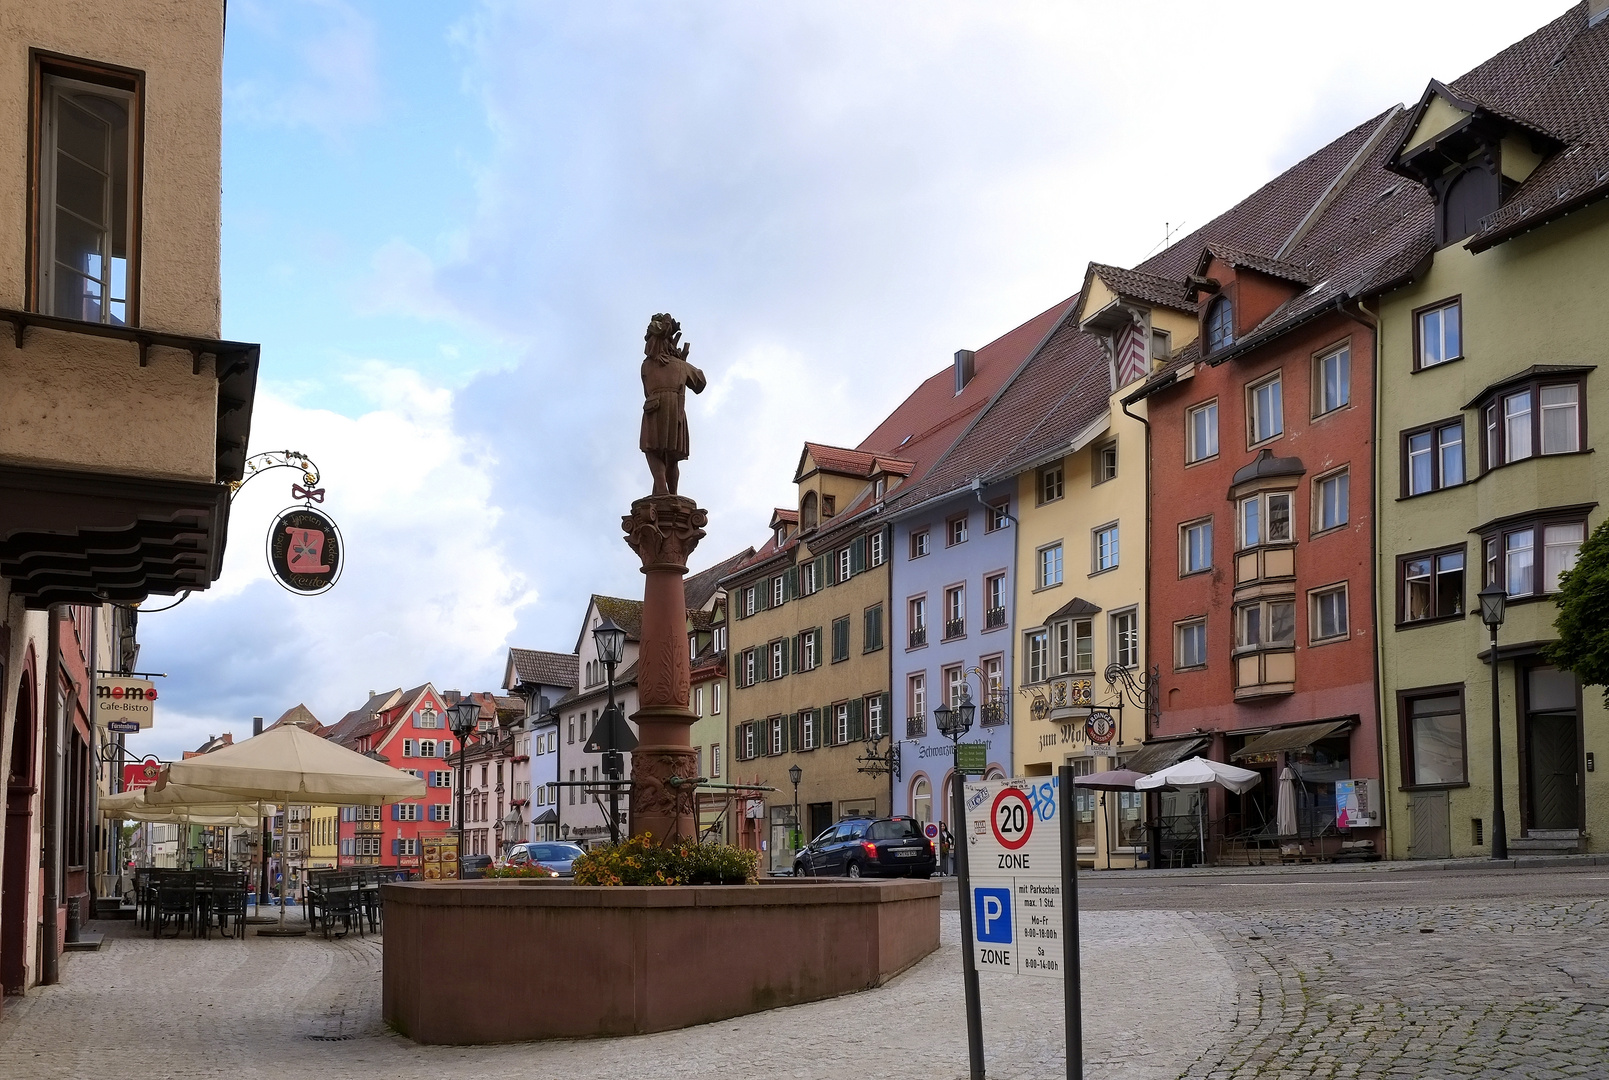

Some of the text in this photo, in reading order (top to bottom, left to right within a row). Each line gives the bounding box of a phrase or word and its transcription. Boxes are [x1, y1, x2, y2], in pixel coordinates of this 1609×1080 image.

[100, 702, 149, 712] Cafe-Bistro
[1088, 711, 1114, 726] ERDINGER
[1038, 733, 1057, 752] zum
[1000, 804, 1025, 833] 20
[997, 854, 1030, 869] ZONE
[1018, 885, 1060, 895] mit Parkschein
[1024, 898, 1056, 908] max. 1 Std.
[983, 895, 1003, 935] P
[1031, 915, 1049, 926] Mo-Fr
[980, 949, 1011, 966] ZONE
[1037, 946, 1045, 957] Sa
